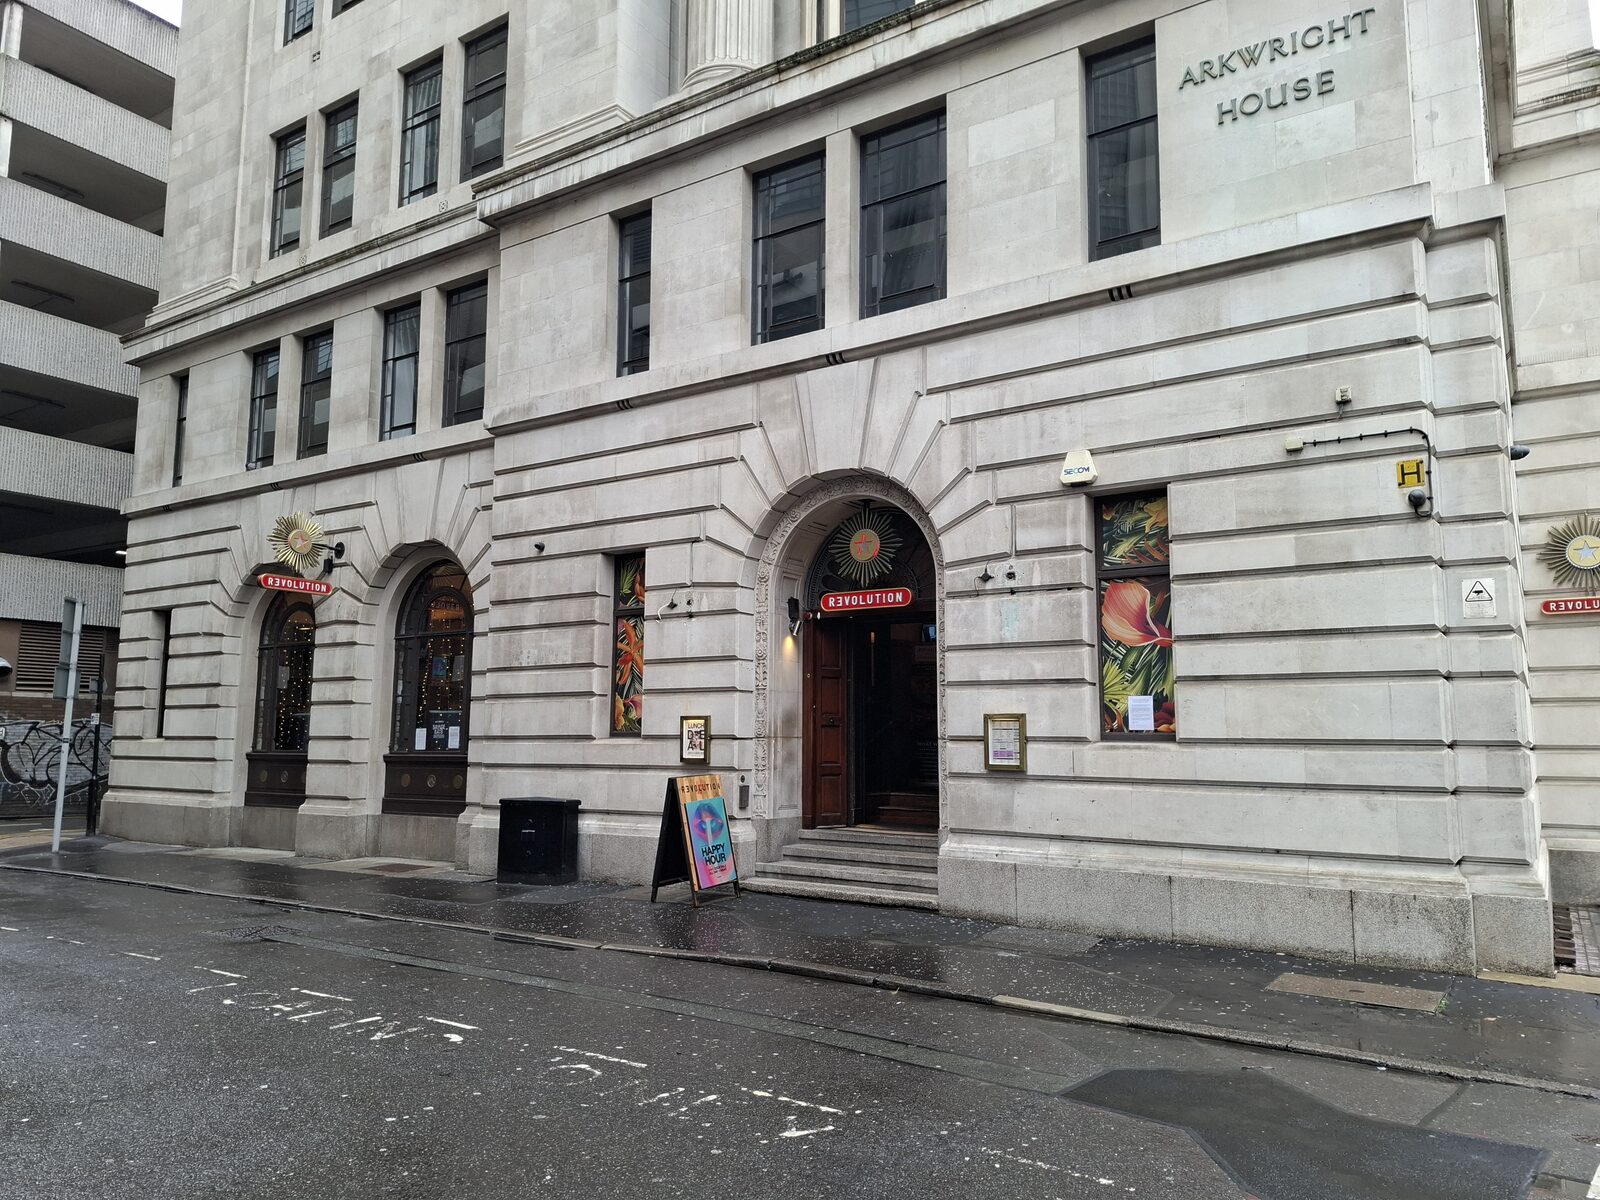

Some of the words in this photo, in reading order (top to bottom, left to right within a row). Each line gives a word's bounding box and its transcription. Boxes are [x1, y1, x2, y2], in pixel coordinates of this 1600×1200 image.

[1179, 7, 1376, 89] ARKWRIGHT
[1217, 68, 1336, 125] HOUSE
[1063, 466, 1090, 475] SECOM
[1400, 462, 1421, 485] H
[268, 577, 327, 592] REVOLUTION
[828, 592, 903, 607] REVOLUTION
[681, 783, 721, 794] REVOLUTION
[701, 843, 726, 857] HAPPY
[704, 853, 727, 866] HOUR
